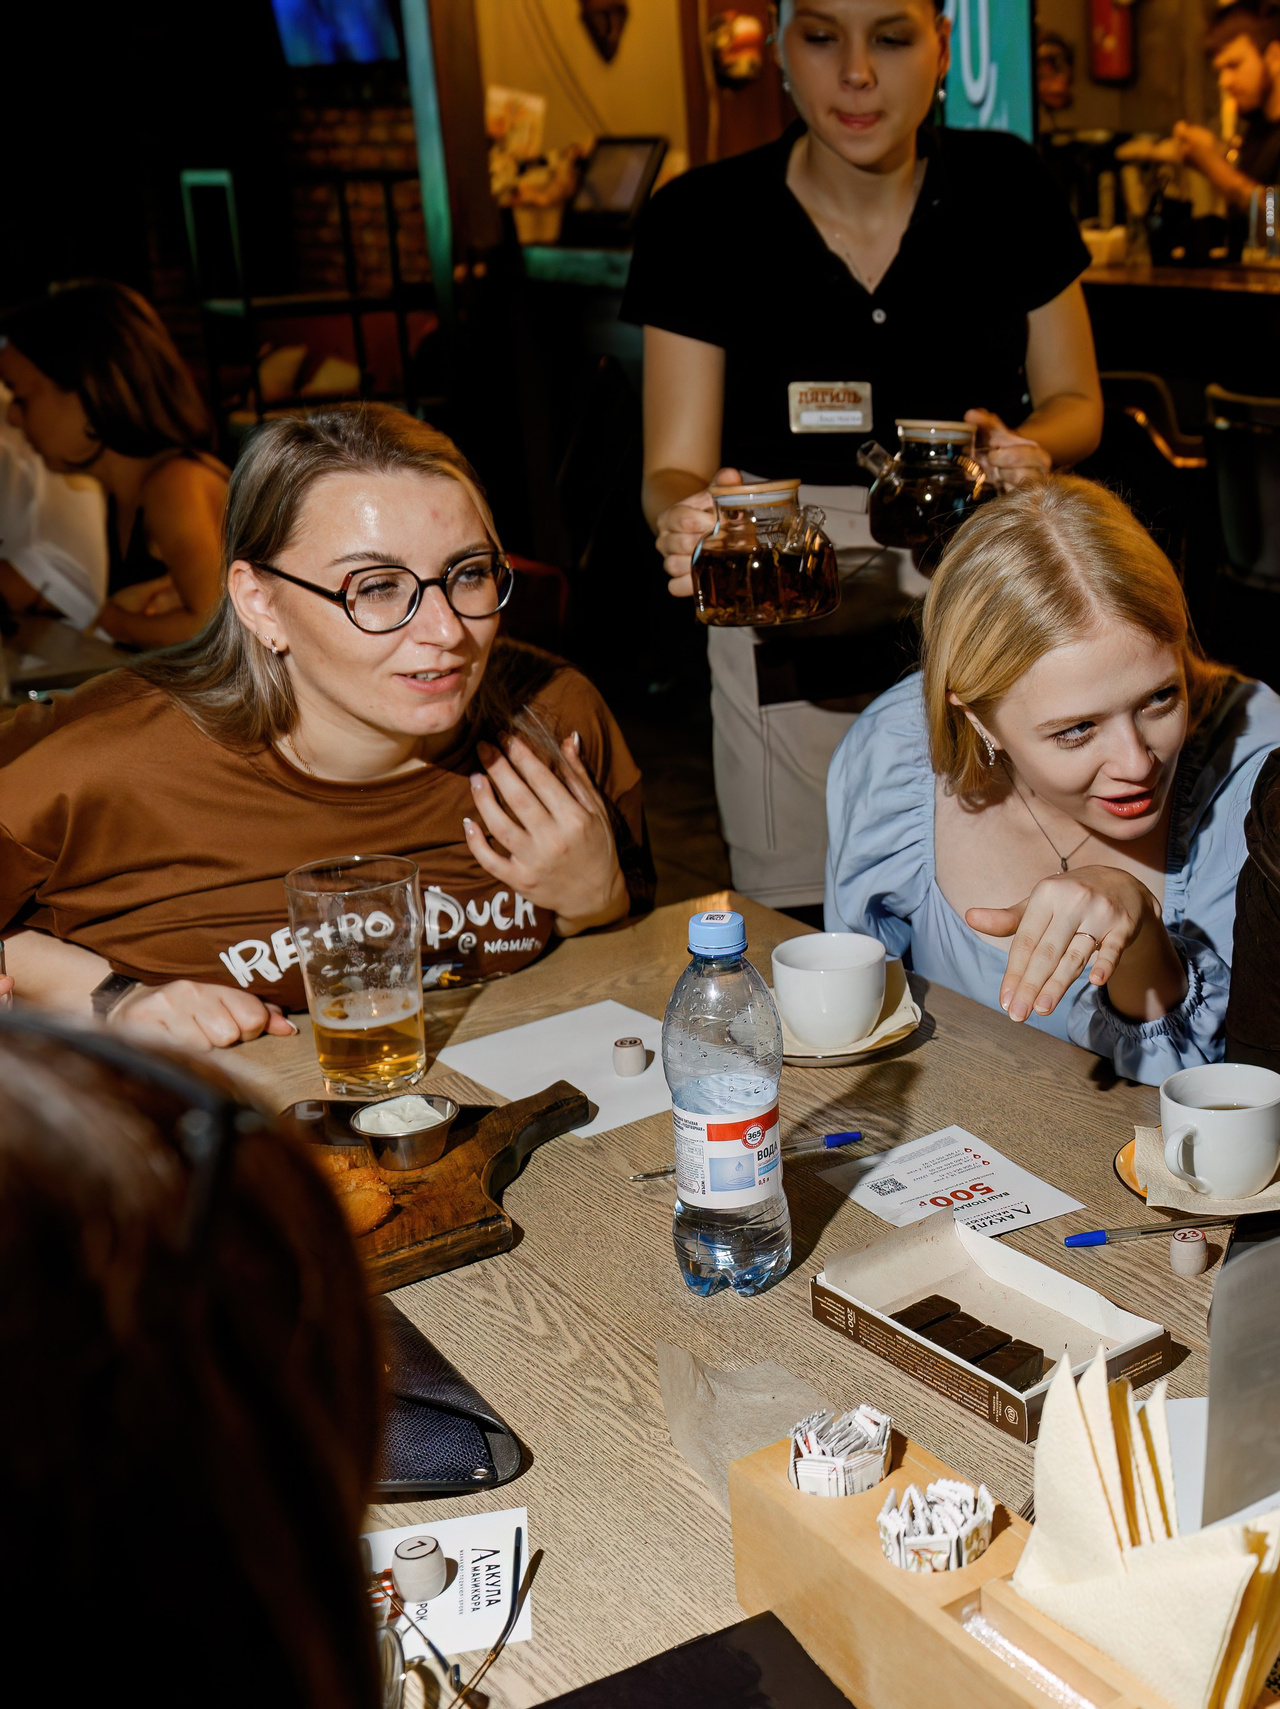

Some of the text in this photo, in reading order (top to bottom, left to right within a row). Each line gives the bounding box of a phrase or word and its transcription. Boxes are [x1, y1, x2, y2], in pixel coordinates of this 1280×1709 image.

[747, 1130, 761, 1140] 365
[757, 1141, 778, 1161] ВОДА
[929, 1182, 995, 1207] 500
[953, 1191, 1010, 1211] ВАШ ПОДАР
[965, 1210, 1010, 1226] МАНИКЮР
[1178, 1230, 1199, 1240] 23
[471, 1565, 481, 1613] МАНИКЮРА
[485, 1564, 501, 1607] АКУЛА
